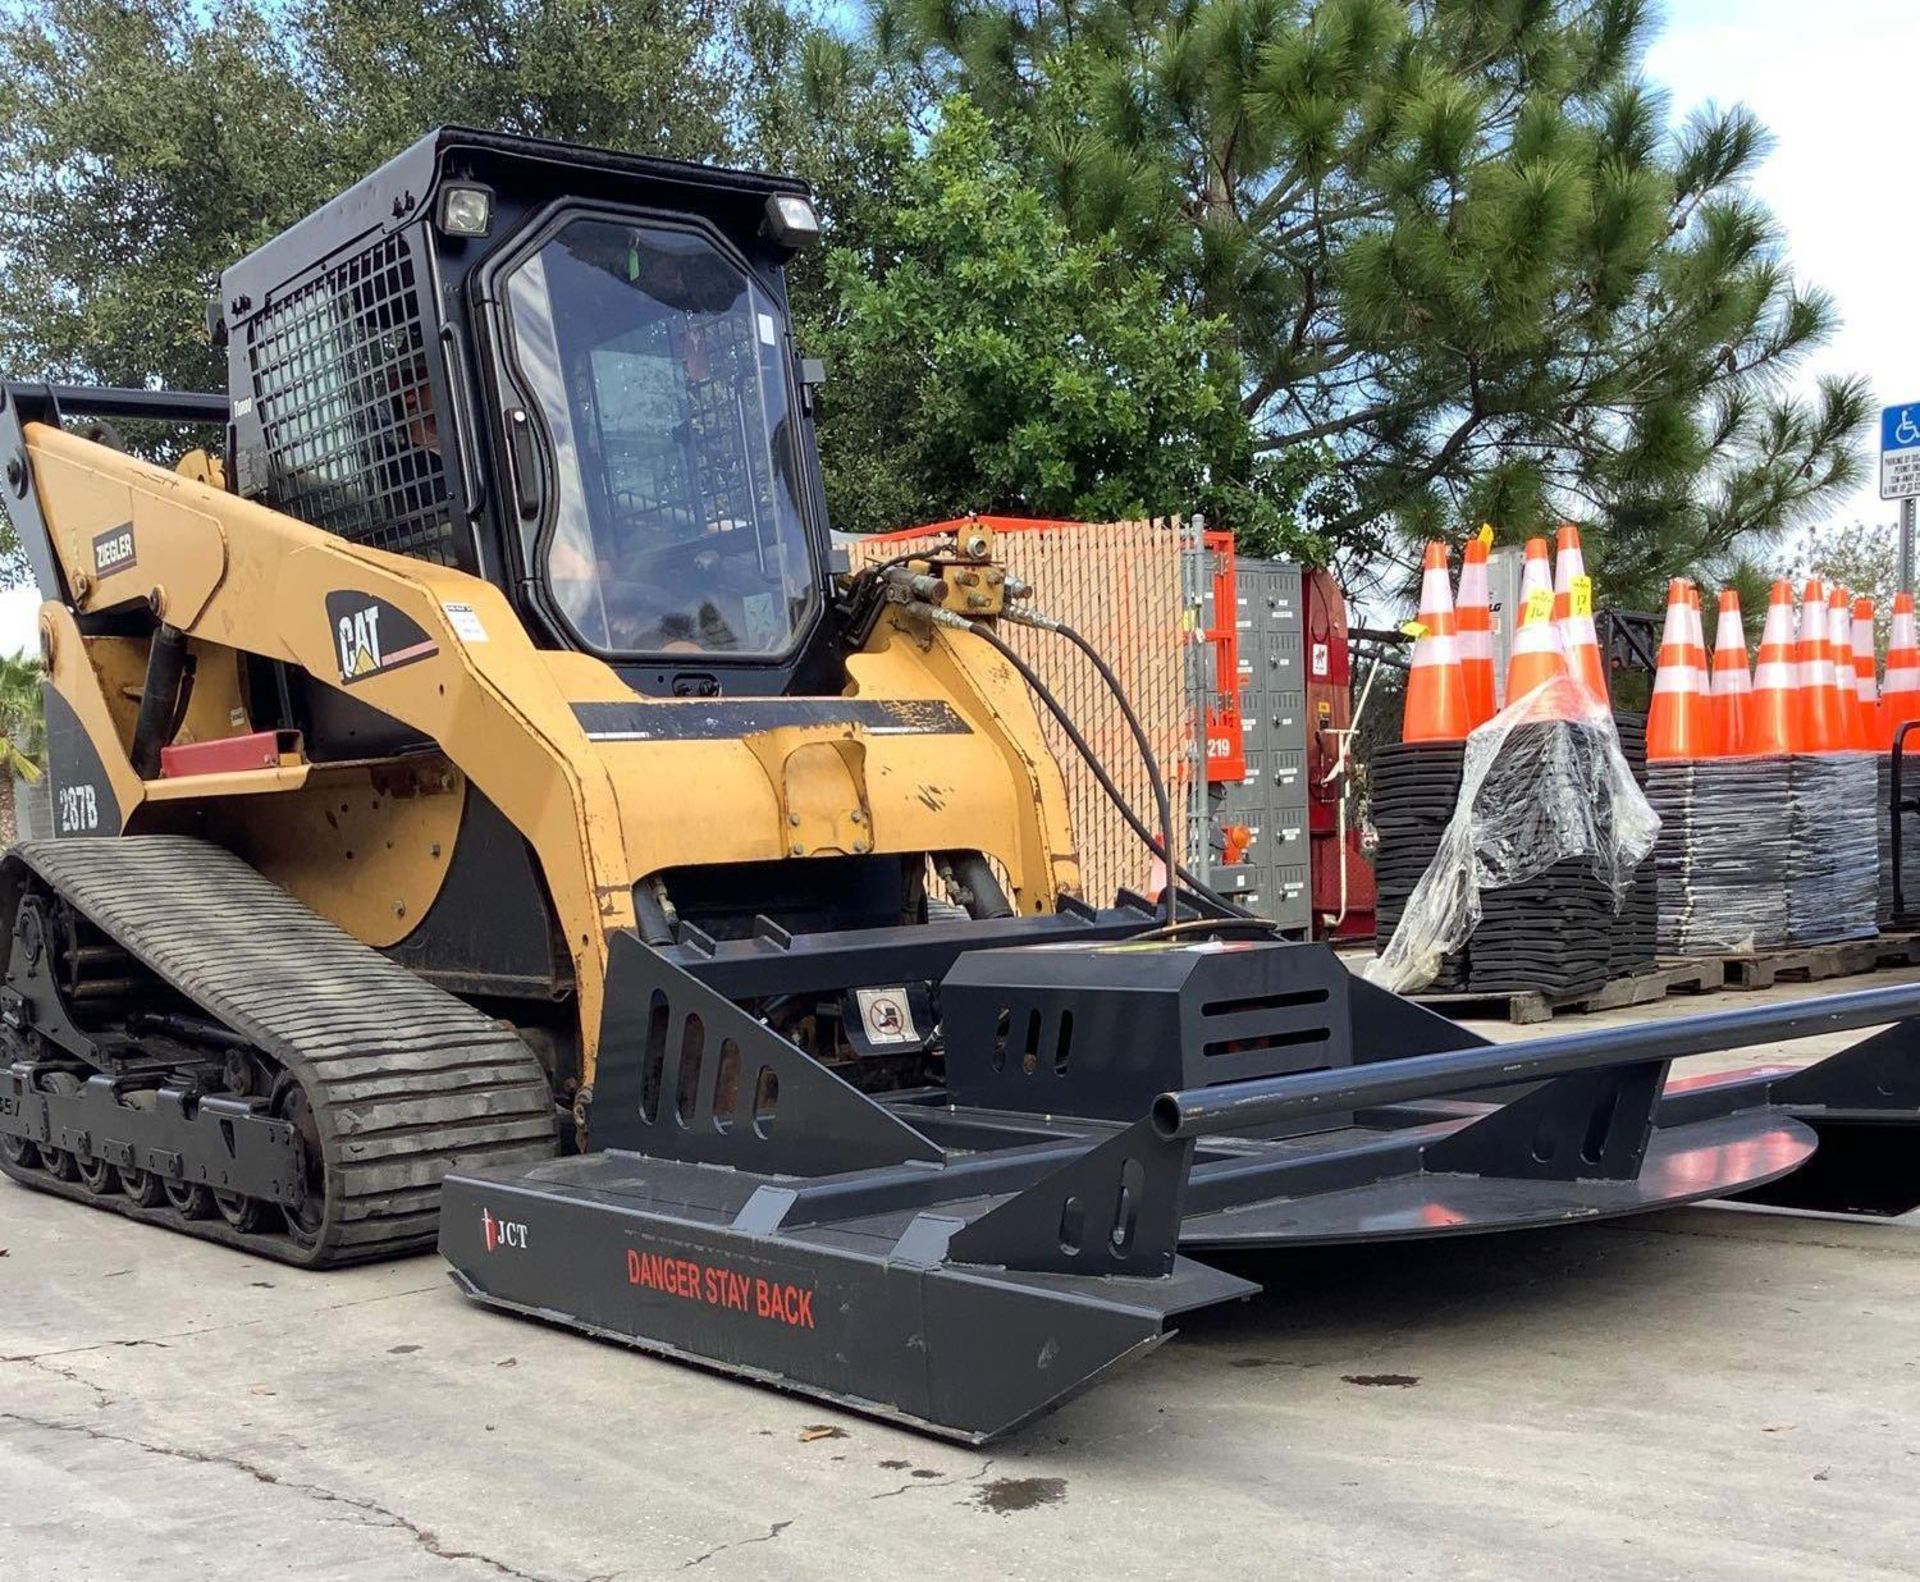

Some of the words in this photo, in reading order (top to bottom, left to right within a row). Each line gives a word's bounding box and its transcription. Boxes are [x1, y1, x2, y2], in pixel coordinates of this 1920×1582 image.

[96, 533, 132, 568] ZIEGLER
[339, 606, 380, 678] CAT
[60, 784, 98, 831] 287B
[497, 1220, 528, 1248] JCT
[627, 1249, 701, 1300] DANGER
[705, 1267, 750, 1312] STAY
[756, 1279, 815, 1329] BACK
